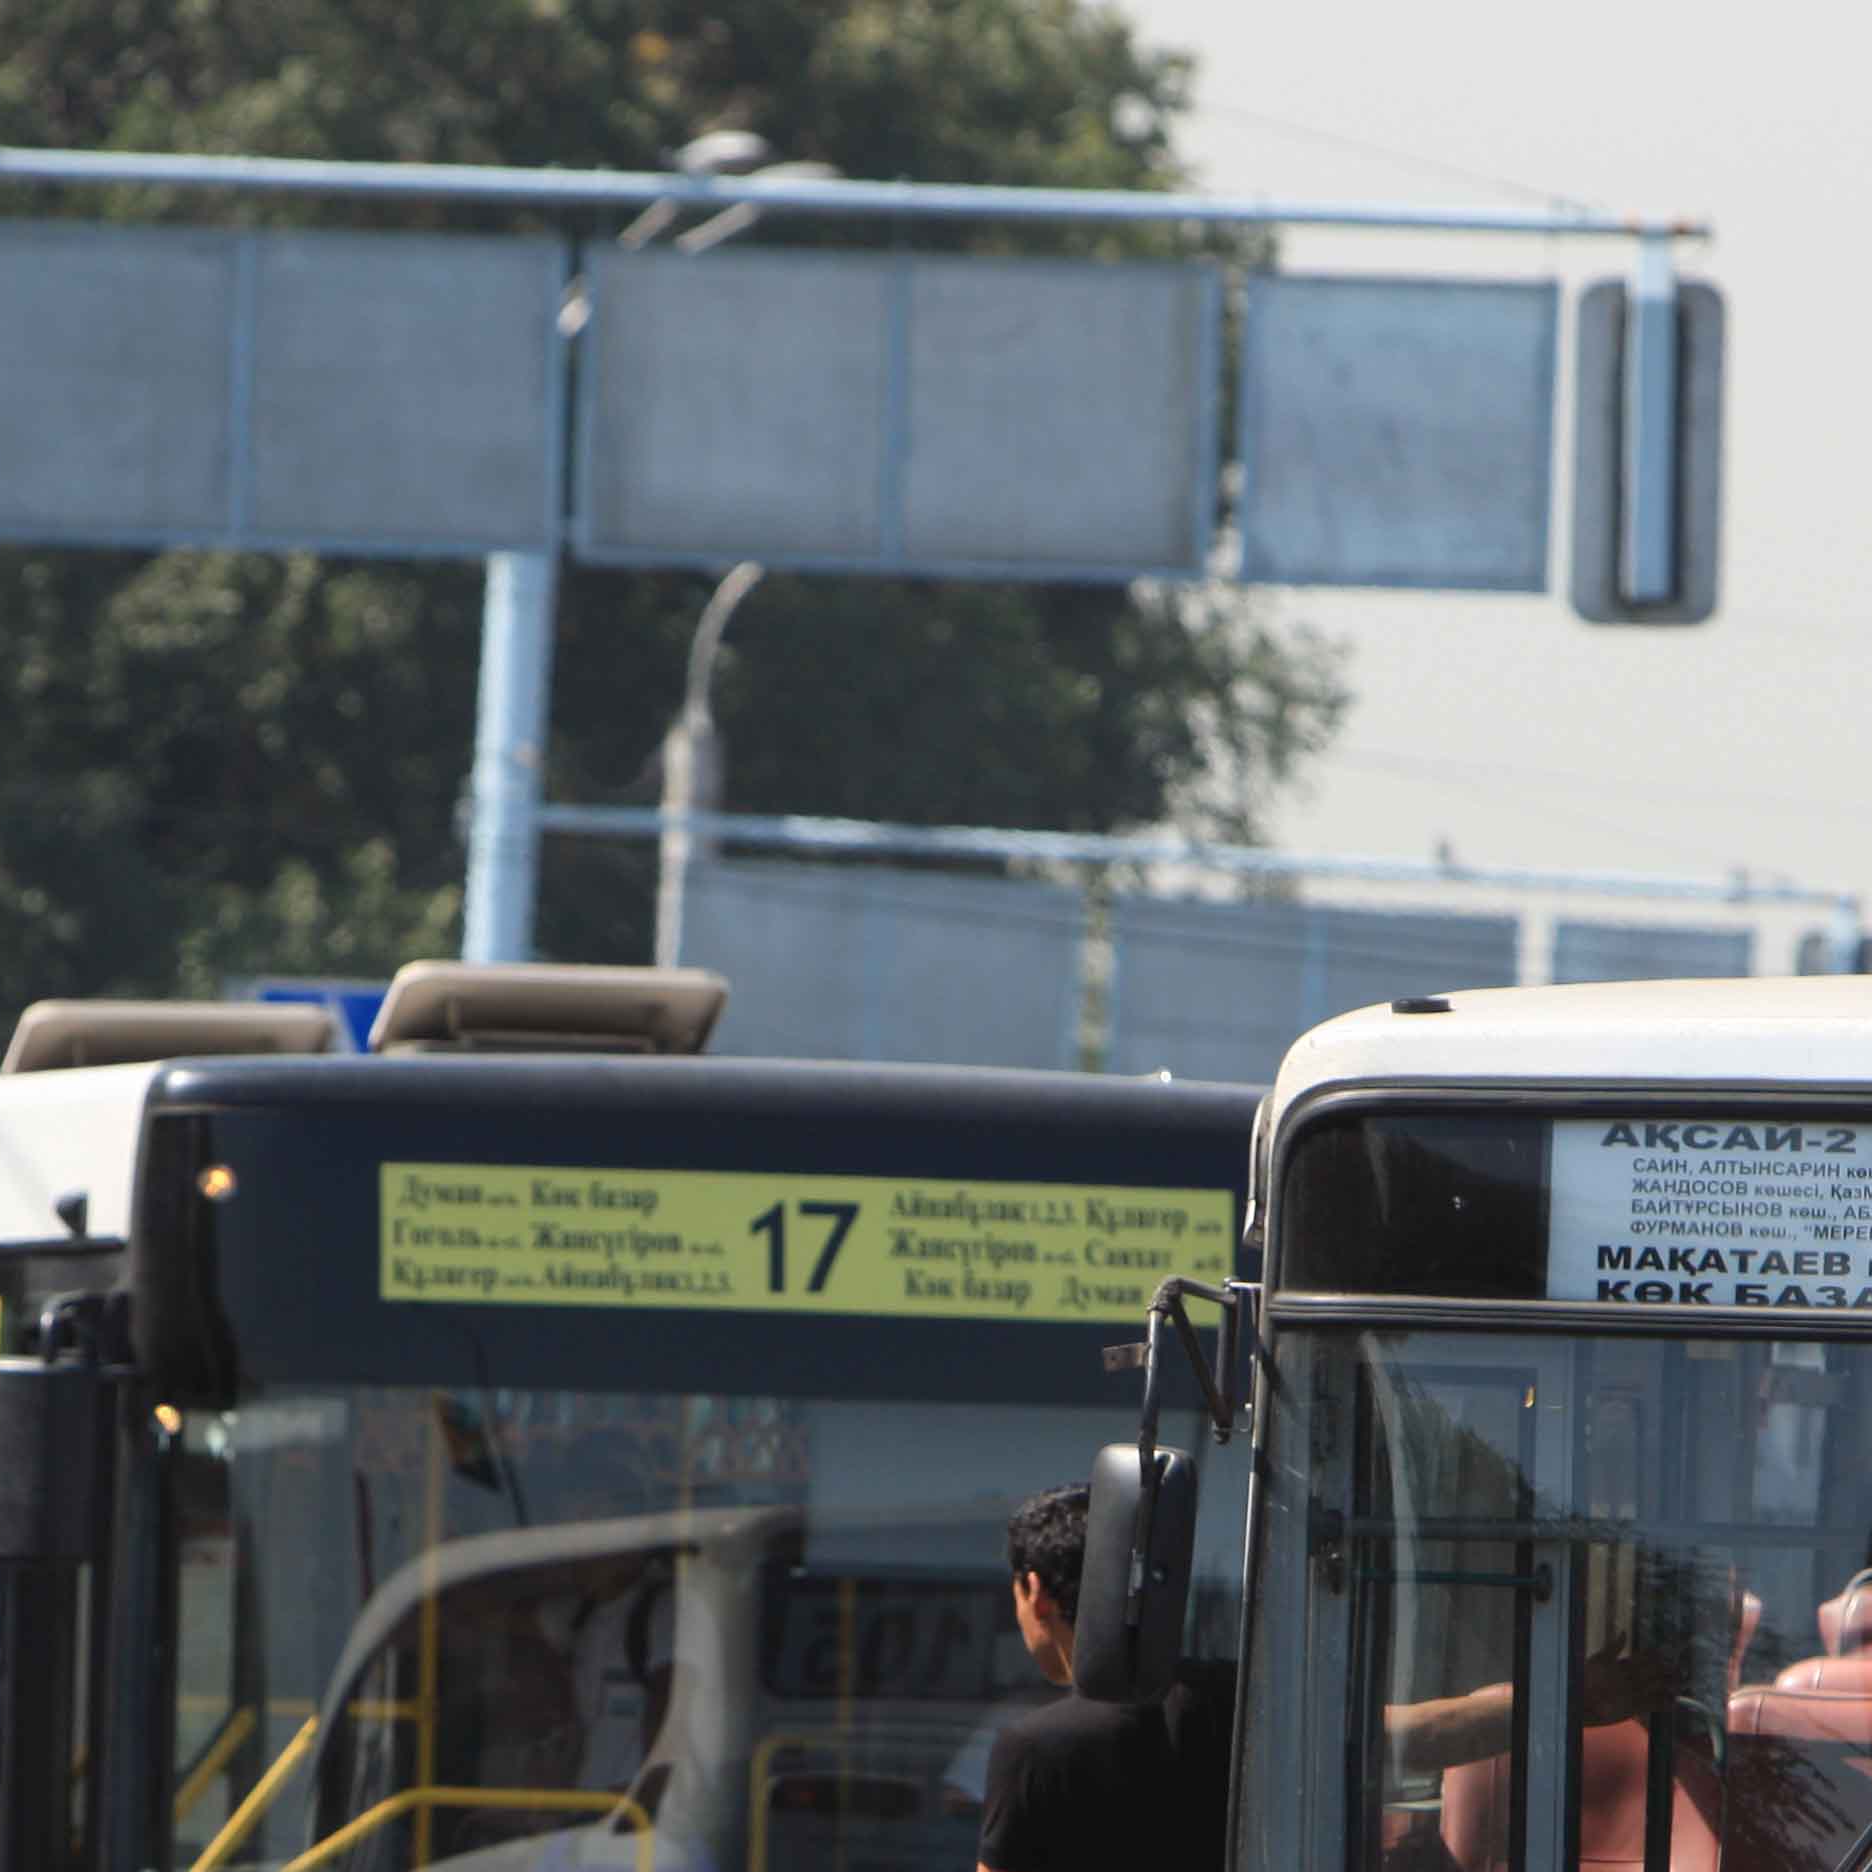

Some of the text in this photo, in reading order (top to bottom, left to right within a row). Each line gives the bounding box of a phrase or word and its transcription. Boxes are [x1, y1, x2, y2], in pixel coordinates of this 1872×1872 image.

[1633, 1157, 1693, 1176] САИН,
[1698, 1159, 1841, 1178] АЛТЫНСАРИН
[1632, 1178, 1748, 1196] ЖАНДОСОВ
[1630, 1220, 1743, 1236] ФУРМАНОВ
[749, 1200, 861, 1292] 17
[1597, 1245, 1851, 1276] МАҚАТАЕВ
[1597, 1280, 1714, 1304] КӨК
